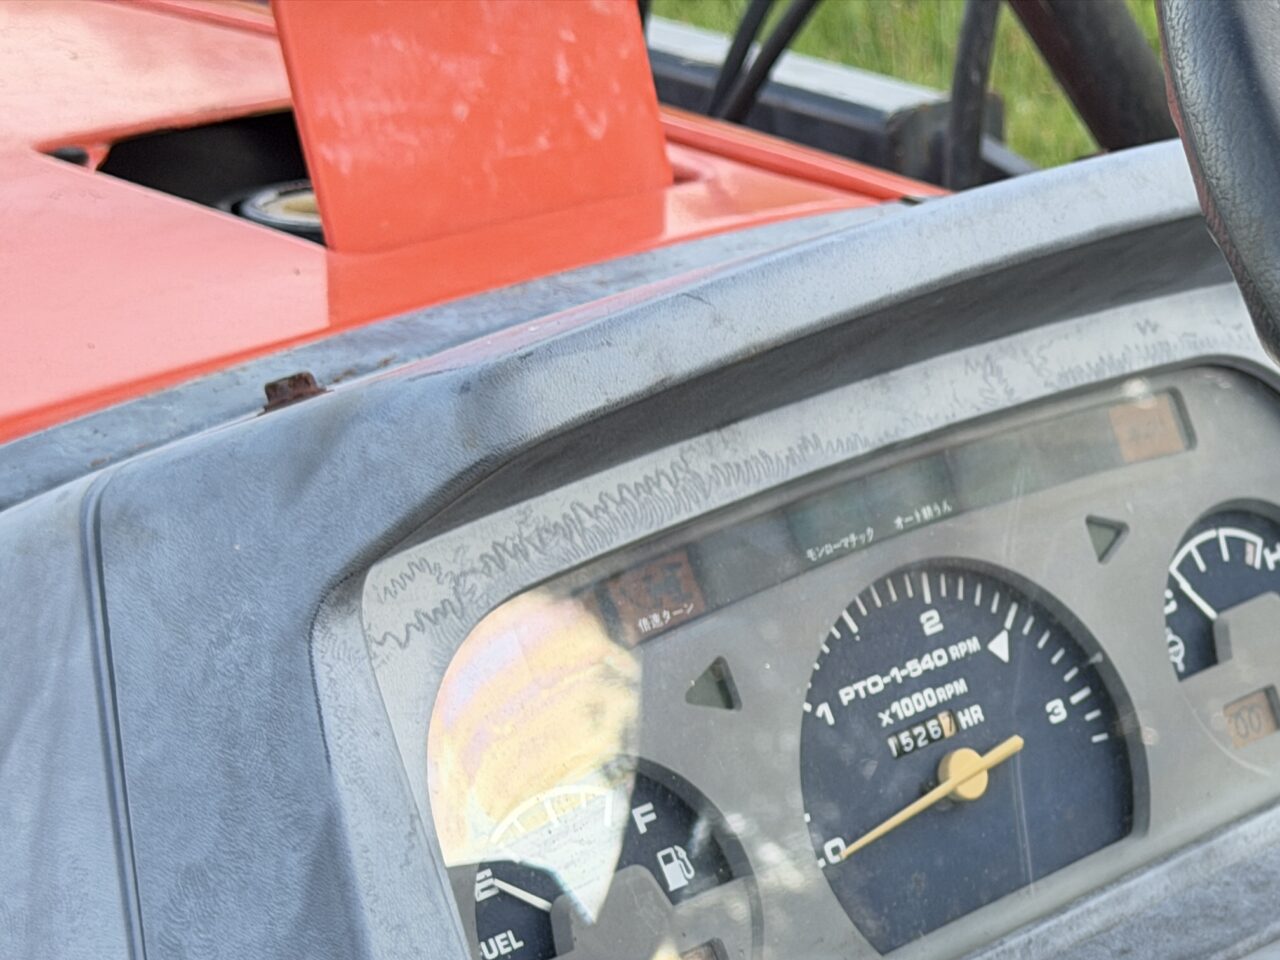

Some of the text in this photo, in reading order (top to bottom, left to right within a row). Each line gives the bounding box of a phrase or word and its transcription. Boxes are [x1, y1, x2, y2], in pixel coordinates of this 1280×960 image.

[919, 609, 944, 636] 2
[815, 703, 835, 726] 1
[957, 704, 985, 730] HR
[1045, 698, 1068, 724] 3
[631, 802, 658, 834] F
[823, 836, 847, 864] 0
